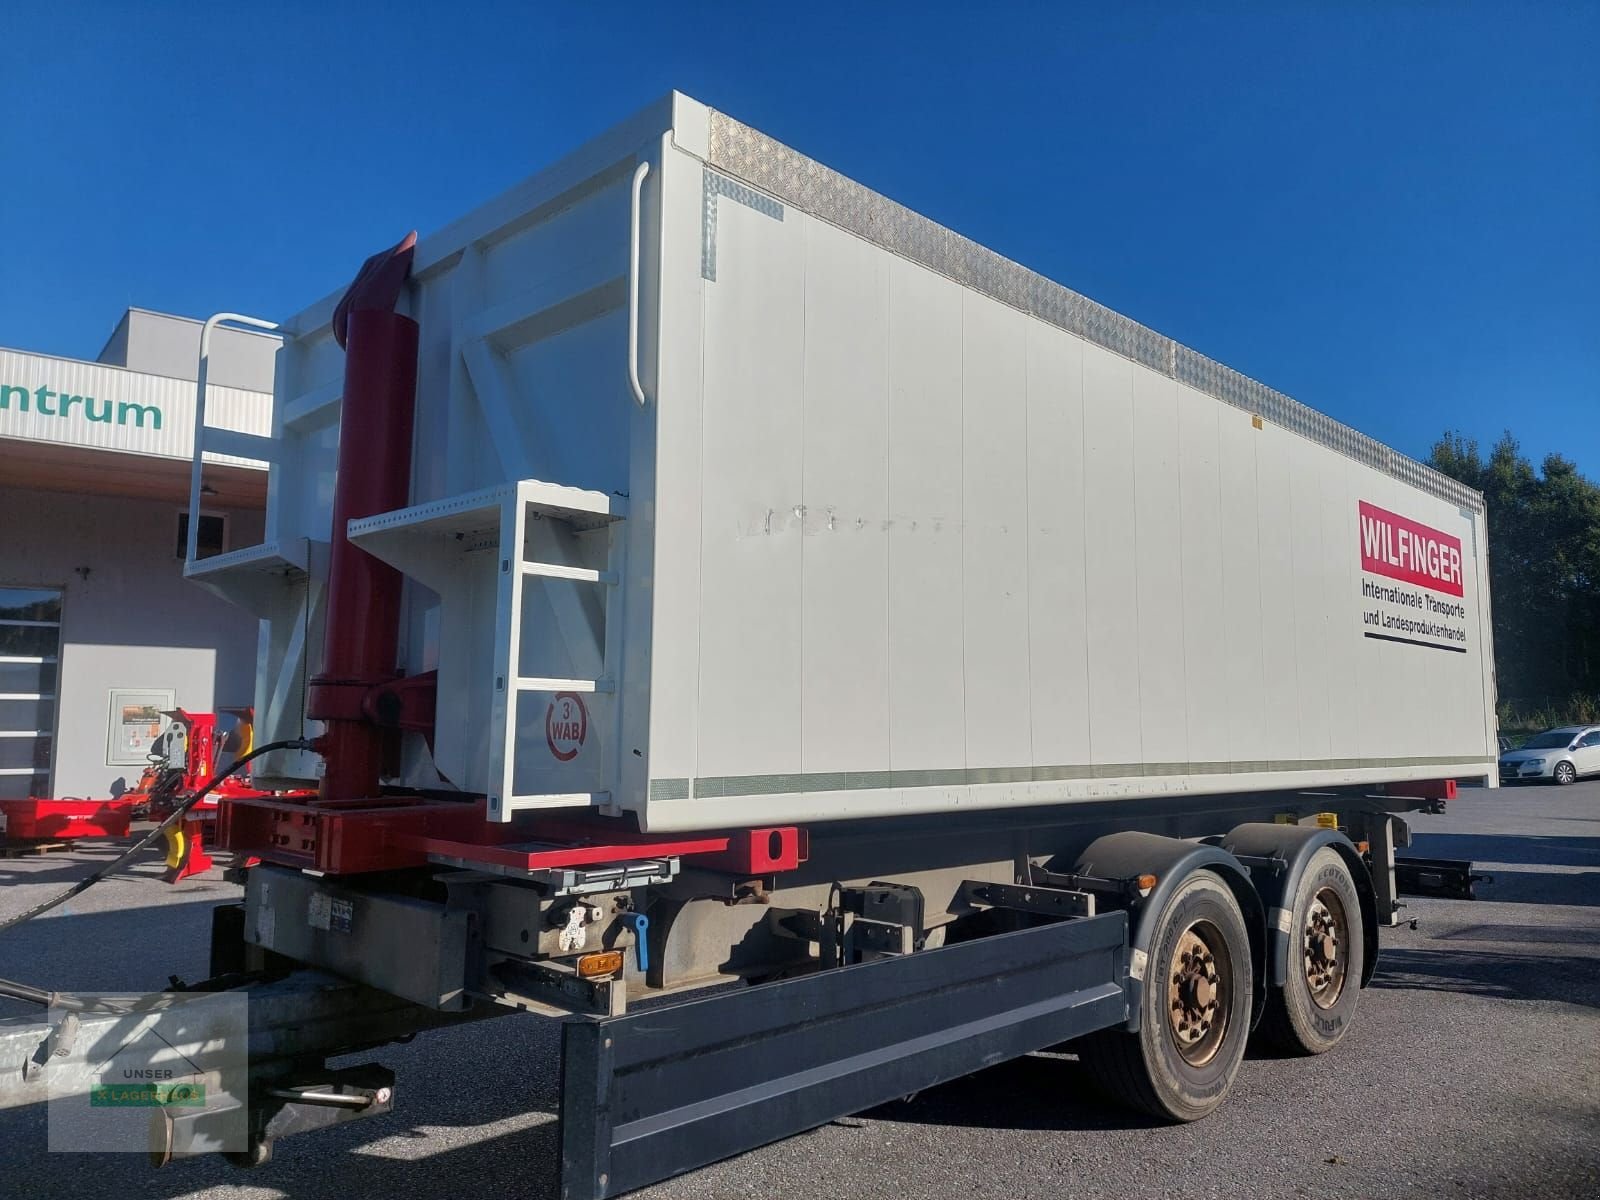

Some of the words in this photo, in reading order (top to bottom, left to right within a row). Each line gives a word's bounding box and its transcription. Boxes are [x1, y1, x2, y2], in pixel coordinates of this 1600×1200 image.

[0, 383, 162, 430] ntrum
[1361, 514, 1462, 586] WILFINGER
[1362, 577, 1423, 609] Internationale
[1425, 593, 1465, 619] Transporte
[1363, 609, 1380, 626] und
[1381, 610, 1467, 642] Landesproduktenhandel
[552, 722, 580, 741] WAB
